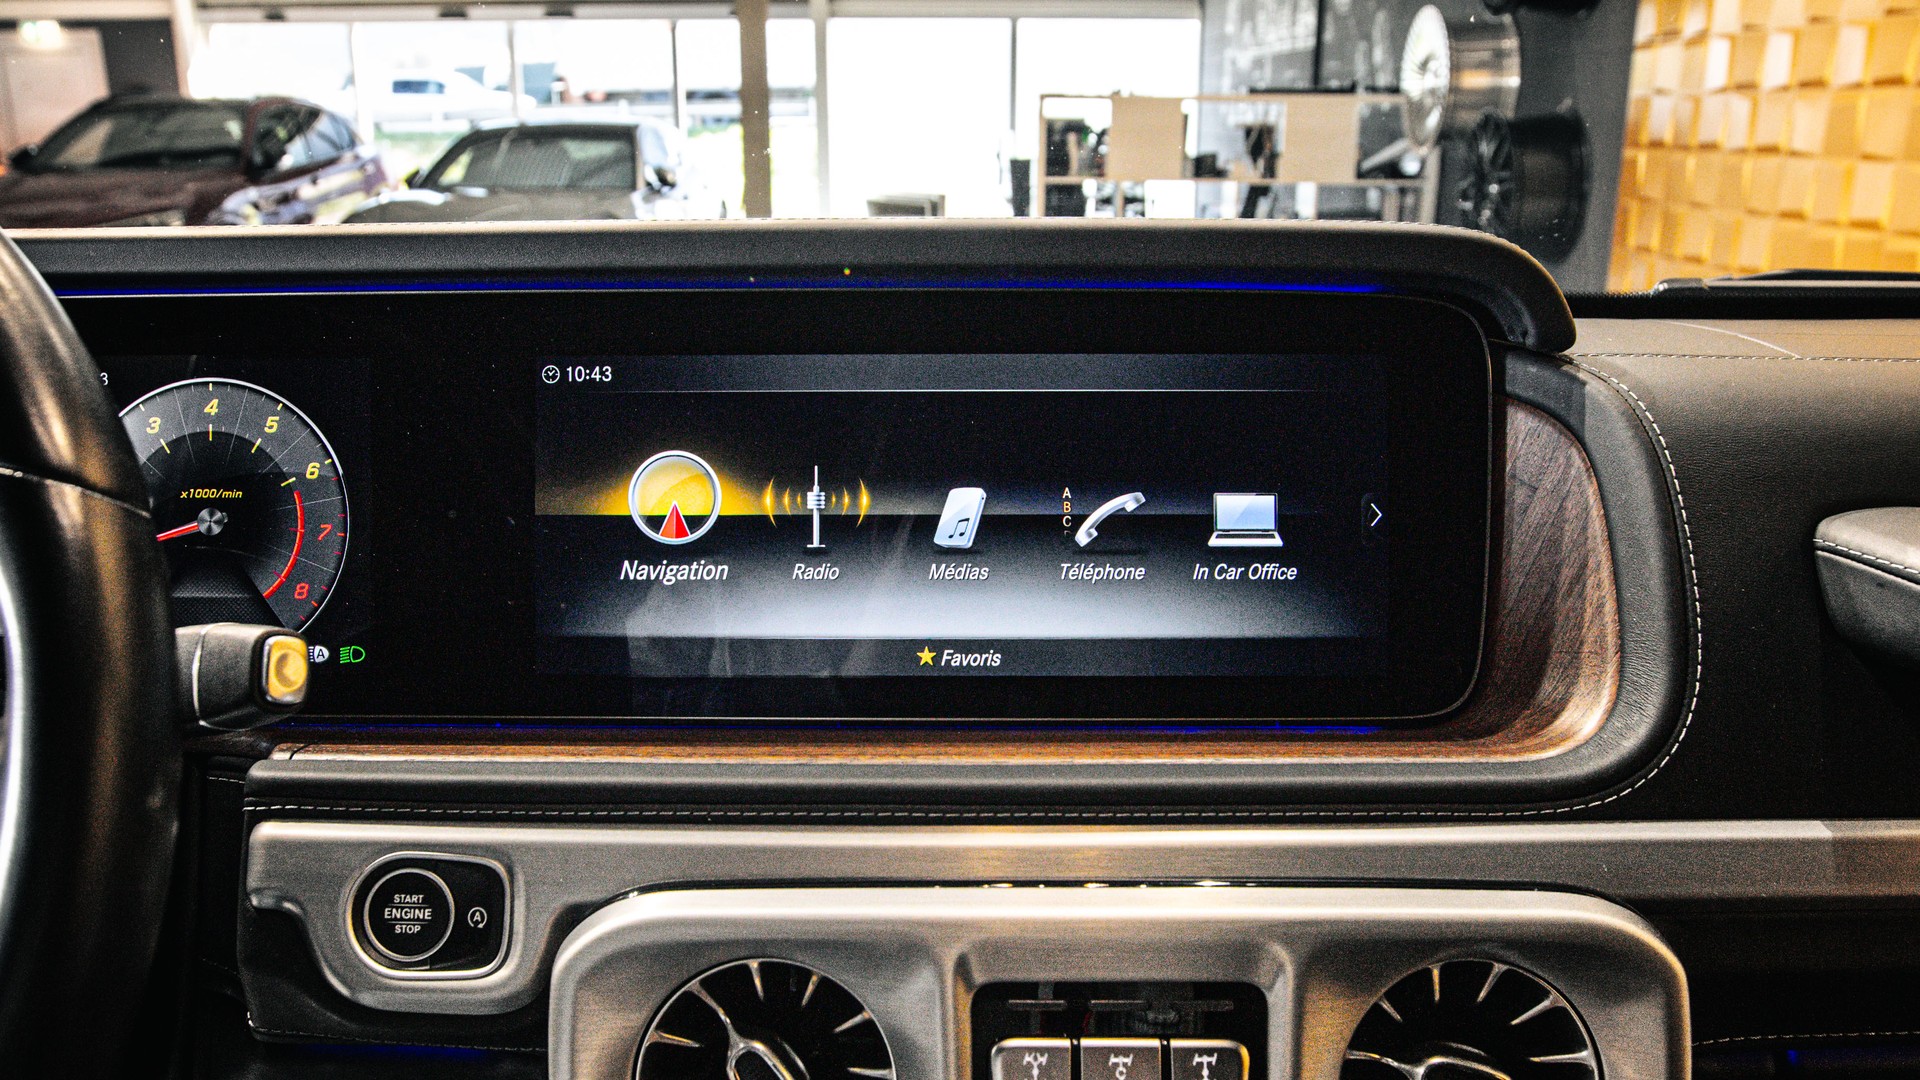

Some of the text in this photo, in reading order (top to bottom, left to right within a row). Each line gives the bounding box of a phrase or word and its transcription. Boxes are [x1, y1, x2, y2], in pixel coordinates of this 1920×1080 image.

[565, 365, 613, 383] 10:43
[204, 399, 219, 416] 4
[146, 417, 161, 434] 3
[264, 416, 280, 433] 5
[305, 462, 320, 479] 6
[180, 488, 243, 500] x1000/min
[317, 524, 333, 541] 7
[619, 560, 729, 585] Navigation
[792, 563, 840, 581] Radio
[929, 563, 989, 581] Médias
[1061, 563, 1146, 584] Téléphone
[1193, 563, 1298, 581] In Car Office
[294, 583, 310, 600] 8
[941, 649, 1001, 668] Favoris
[393, 894, 424, 904] START
[384, 907, 432, 920] ENGINE
[394, 924, 421, 934] STOP
